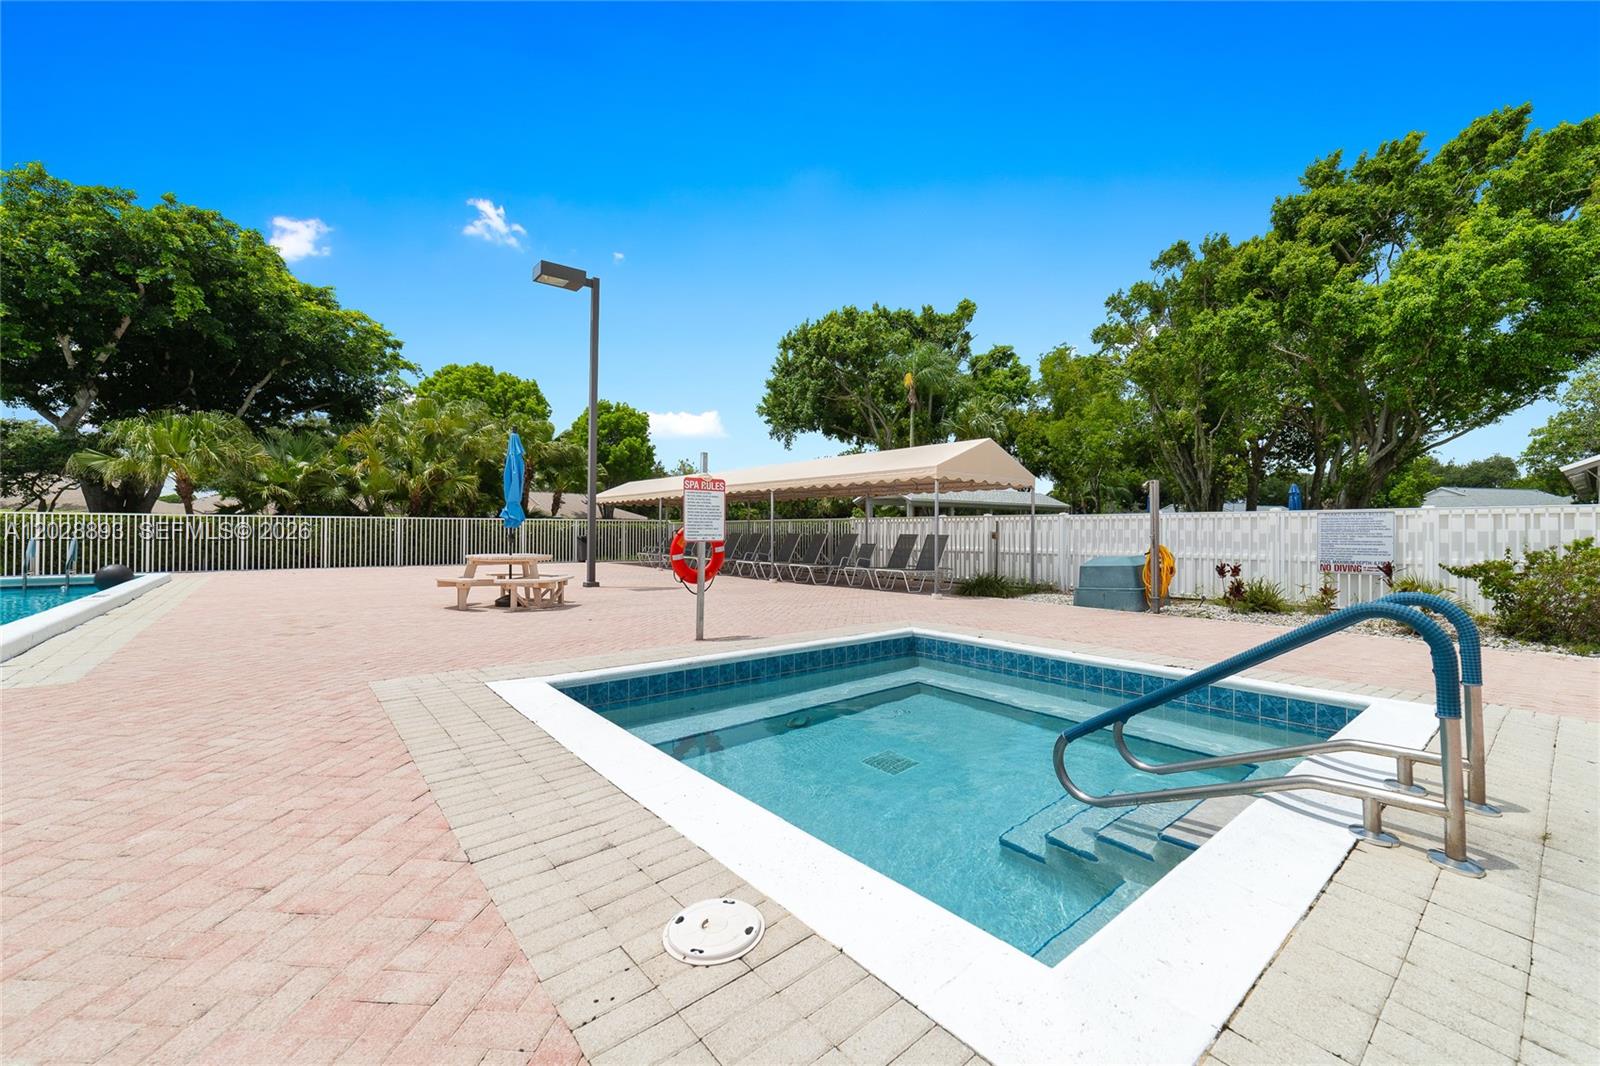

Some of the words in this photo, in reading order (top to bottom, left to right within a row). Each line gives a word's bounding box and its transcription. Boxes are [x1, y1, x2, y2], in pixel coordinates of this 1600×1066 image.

[684, 480, 699, 489] SPA
[701, 482, 725, 490] RULES
[1320, 564, 1332, 572] NO
[1334, 564, 1362, 572] DIVING
